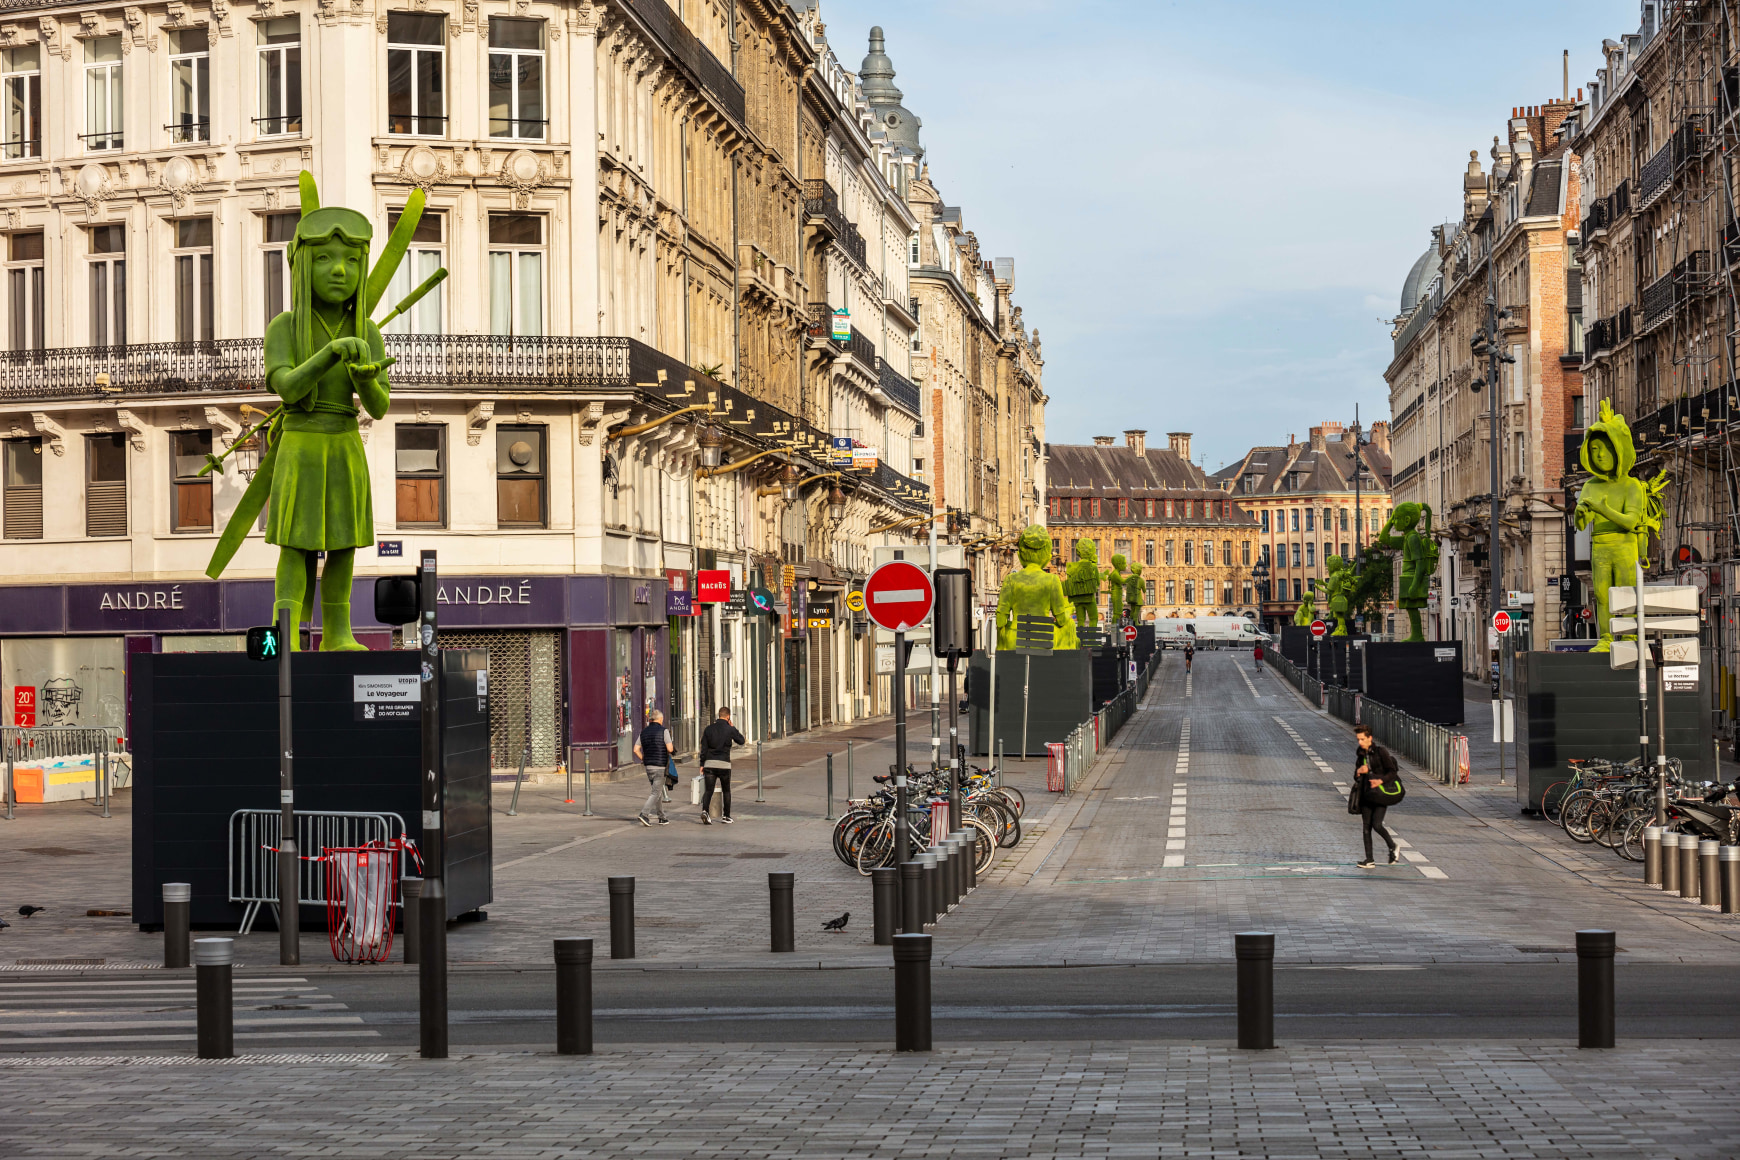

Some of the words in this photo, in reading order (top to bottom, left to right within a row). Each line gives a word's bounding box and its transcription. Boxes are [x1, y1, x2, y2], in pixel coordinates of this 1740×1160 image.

[100, 585, 184, 610] ANDRÉ
[437, 579, 532, 605] ANDRÉ
[20, 714, 27, 727] 2
